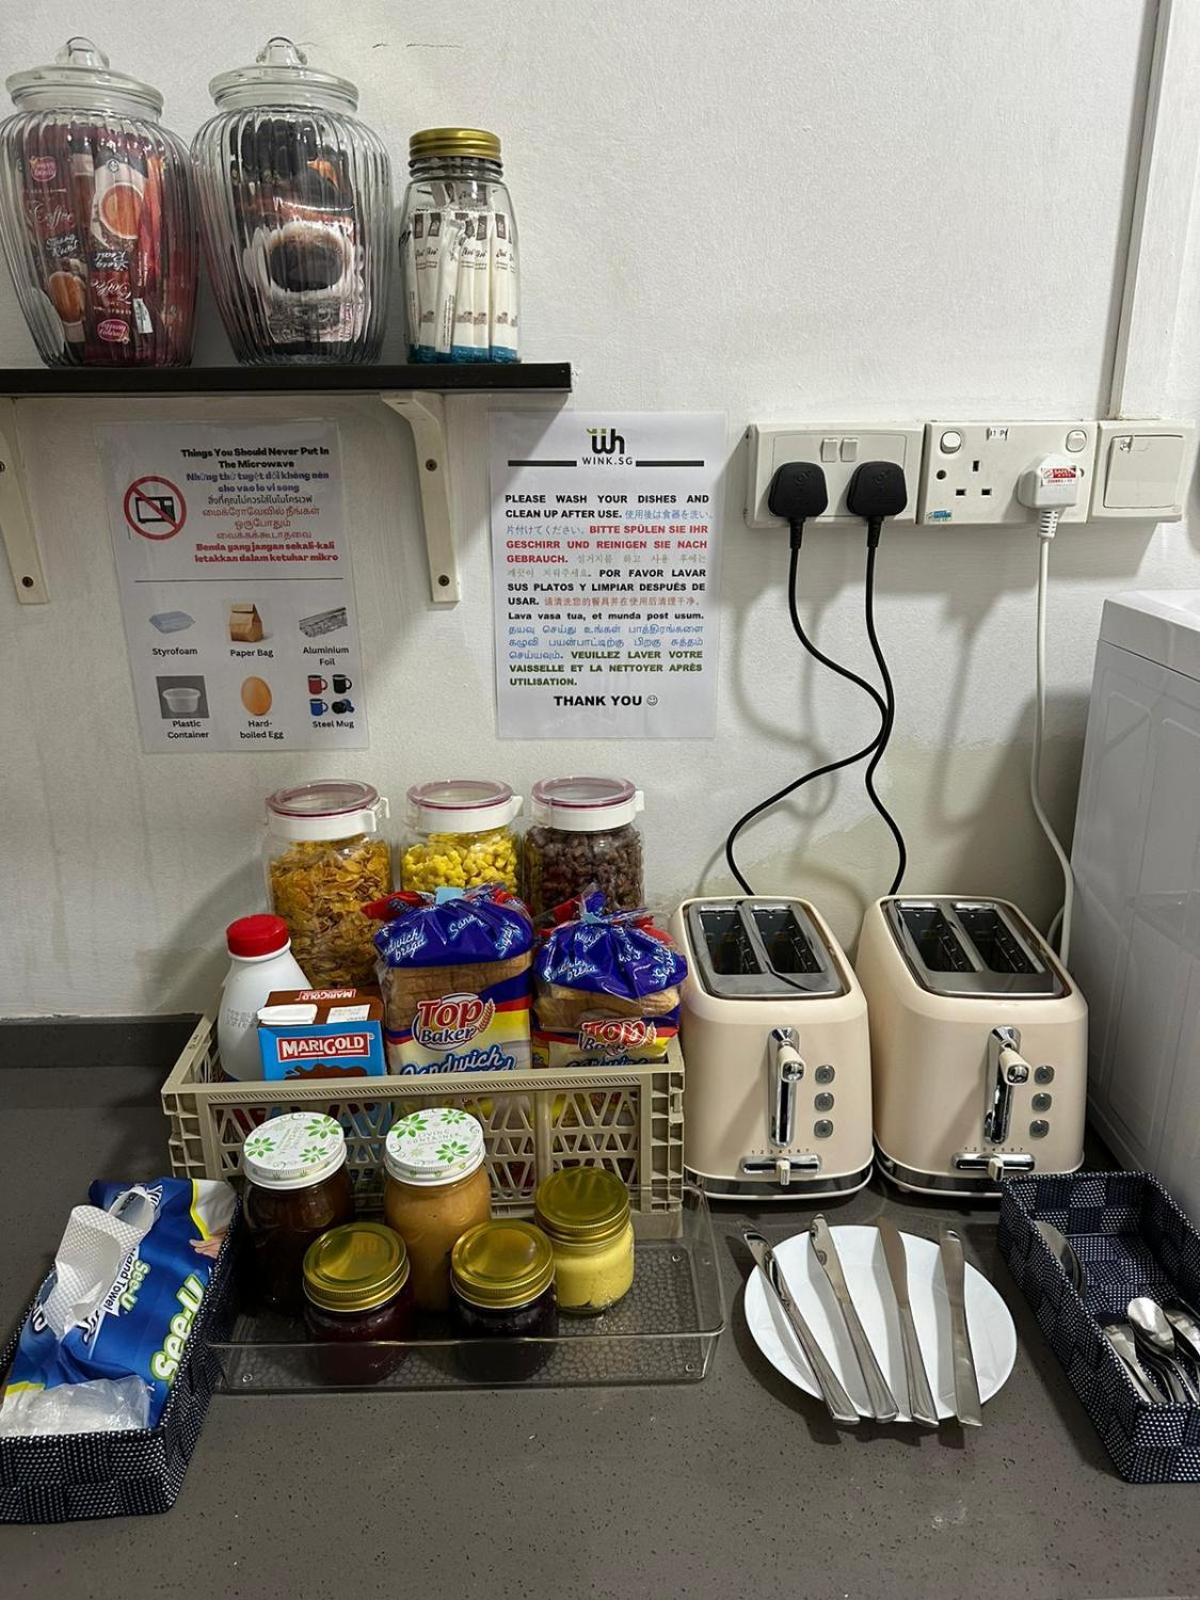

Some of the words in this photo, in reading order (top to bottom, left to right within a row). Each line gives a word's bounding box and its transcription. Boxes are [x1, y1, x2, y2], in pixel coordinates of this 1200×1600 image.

[181, 449, 213, 459] Things
[215, 449, 232, 457] You
[234, 448, 267, 457] Should
[269, 448, 299, 456] Never
[300, 447, 318, 455] Put
[320, 447, 329, 455] In
[218, 460, 236, 469] The
[238, 460, 294, 468] Microwave
[582, 457, 633, 465] WINK.SG
[218, 484, 235, 493] cho
[505, 495, 546, 503] PLEASE
[556, 495, 587, 503] WASH
[597, 495, 628, 503] YOUR
[638, 495, 677, 503] DISHES
[686, 495, 709, 503] AND
[505, 510, 541, 518] CLEAN
[544, 510, 558, 518] UP
[561, 510, 595, 518] AFTER
[598, 510, 622, 518] USE.
[589, 525, 620, 534] BITTE
[623, 523, 665, 534] SPÜLEN
[669, 525, 687, 533] SIE
[689, 525, 708, 533] IHR
[196, 543, 226, 551] Benda
[227, 543, 251, 553] yang
[252, 542, 285, 552] jangan
[285, 541, 335, 550] sekali-kali
[506, 540, 560, 549] GESCHIRR
[567, 540, 589, 548] UND
[596, 540, 647, 549] REINIGEN
[654, 540, 671, 549] SIE
[677, 541, 707, 549] NACH
[269, 554, 309, 562] ketuhar
[310, 553, 339, 561] mikro
[507, 555, 568, 563] GEBRAUCH.
[599, 569, 620, 577] POR
[629, 569, 664, 577] FAVOR
[671, 569, 706, 577] LAVAR
[508, 583, 528, 591] SUS
[533, 583, 574, 591] PLATOS
[579, 583, 586, 591] Y
[591, 583, 634, 591] LIMPIAR
[639, 581, 687, 591] DESPUÉS
[692, 583, 706, 591] DE
[508, 597, 539, 606] USAR.
[508, 612, 532, 620] Lava
[567, 613, 586, 621] tua,
[608, 612, 641, 620] munda
[647, 613, 668, 621] post
[152, 647, 198, 656] Styrofoam
[230, 649, 256, 657] Paper
[257, 649, 274, 658] Bag
[303, 645, 350, 655] Aluminium
[571, 651, 620, 659] VEUILLEZ
[627, 651, 661, 659] LAVER
[319, 658, 335, 666] Foil
[509, 665, 564, 673] VAISSELLE
[571, 665, 583, 673] ET
[609, 664, 663, 672] NETTOYER
[669, 662, 702, 672] APRÈS
[509, 678, 577, 686] UTILISATION.
[554, 696, 606, 706] THANK
[611, 696, 642, 706] YOU
[172, 720, 201, 728] Plastic
[247, 719, 273, 727] Hard-
[312, 720, 335, 728] Steel
[336, 719, 355, 729] Mug
[167, 731, 209, 739] Container
[240, 730, 267, 739] boiled
[268, 731, 284, 739] Egg
[418, 997, 484, 1028] Top
[420, 1025, 478, 1043] Baker
[282, 1035, 365, 1059] MARIGOLD
[119, 1259, 152, 1312] See-U
[149, 1273, 205, 1384] See-U
